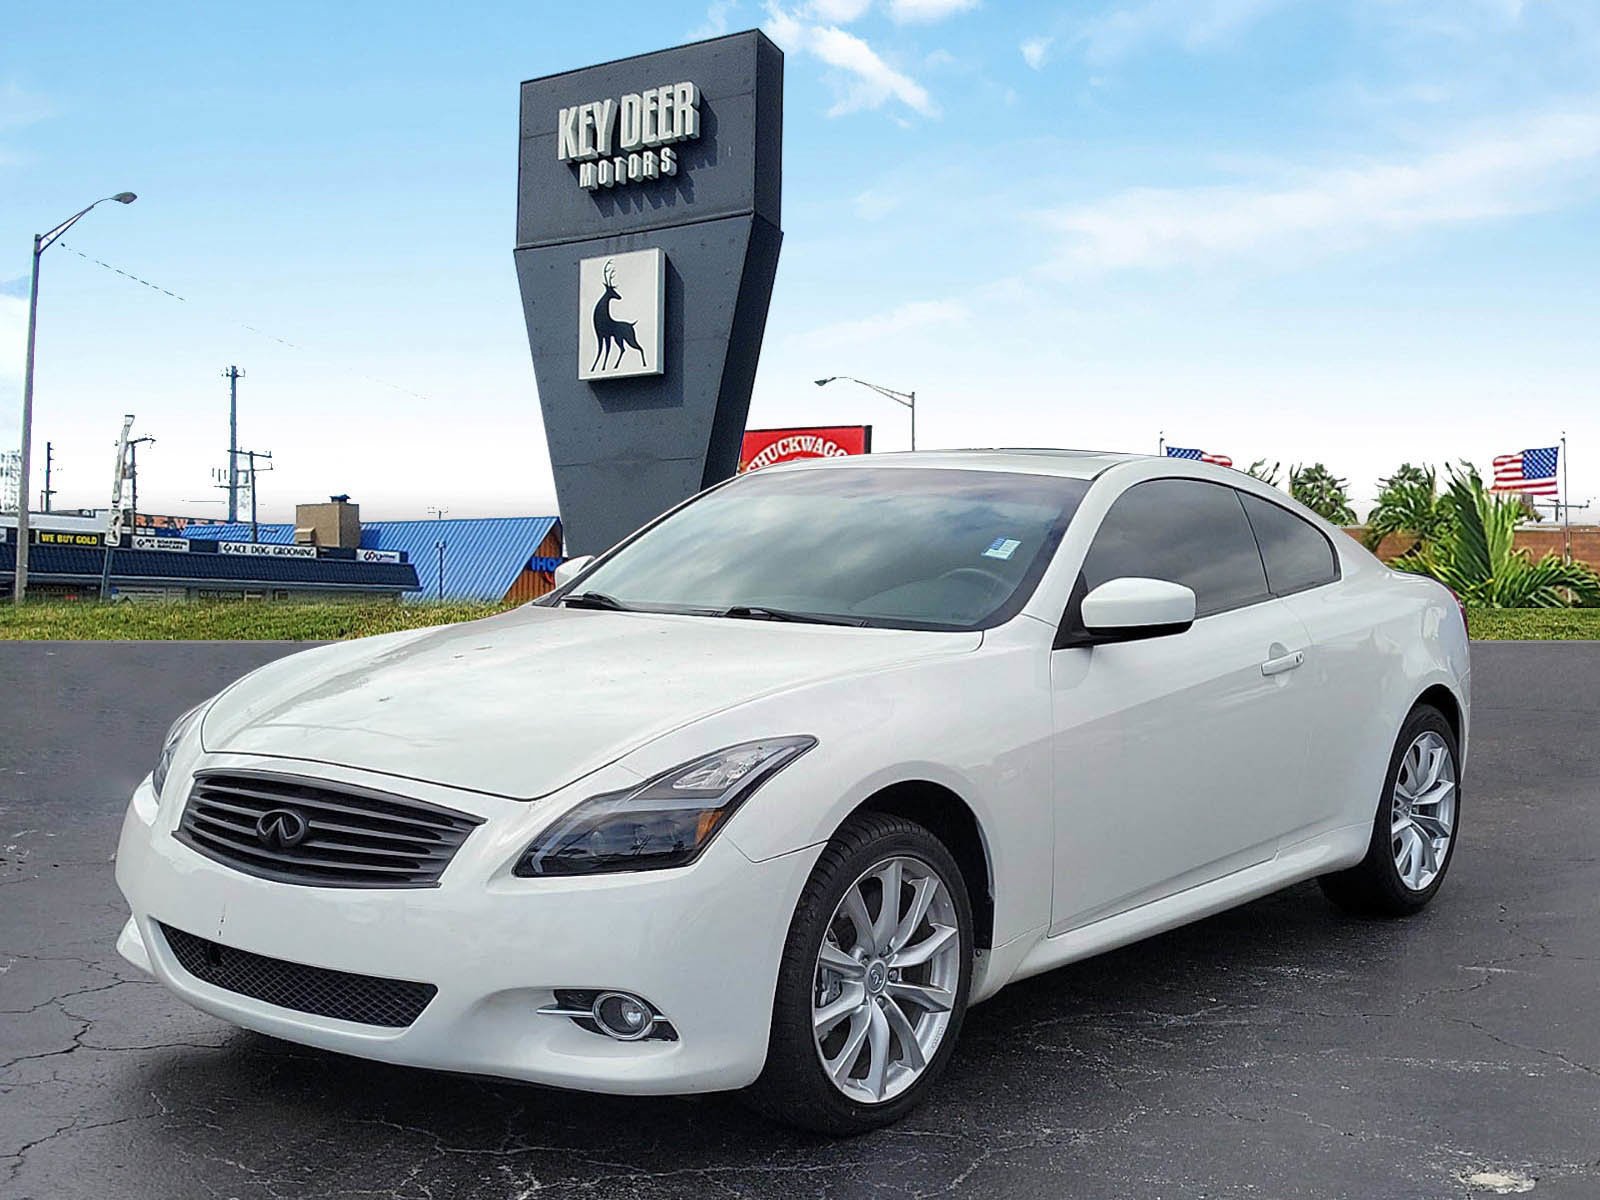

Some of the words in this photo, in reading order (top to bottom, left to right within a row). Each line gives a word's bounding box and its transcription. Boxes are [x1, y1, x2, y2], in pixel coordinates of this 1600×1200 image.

[558, 99, 617, 161] KEY
[620, 82, 700, 152] DEER
[579, 147, 677, 190] MOTORS
[41, 533, 55, 543] WE
[57, 534, 74, 544] BUY
[76, 535, 97, 545] GOLD
[232, 544, 247, 553] ACE
[251, 545, 270, 555] DOG
[272, 547, 315, 557] GROOMING
[531, 556, 560, 571] IHO
